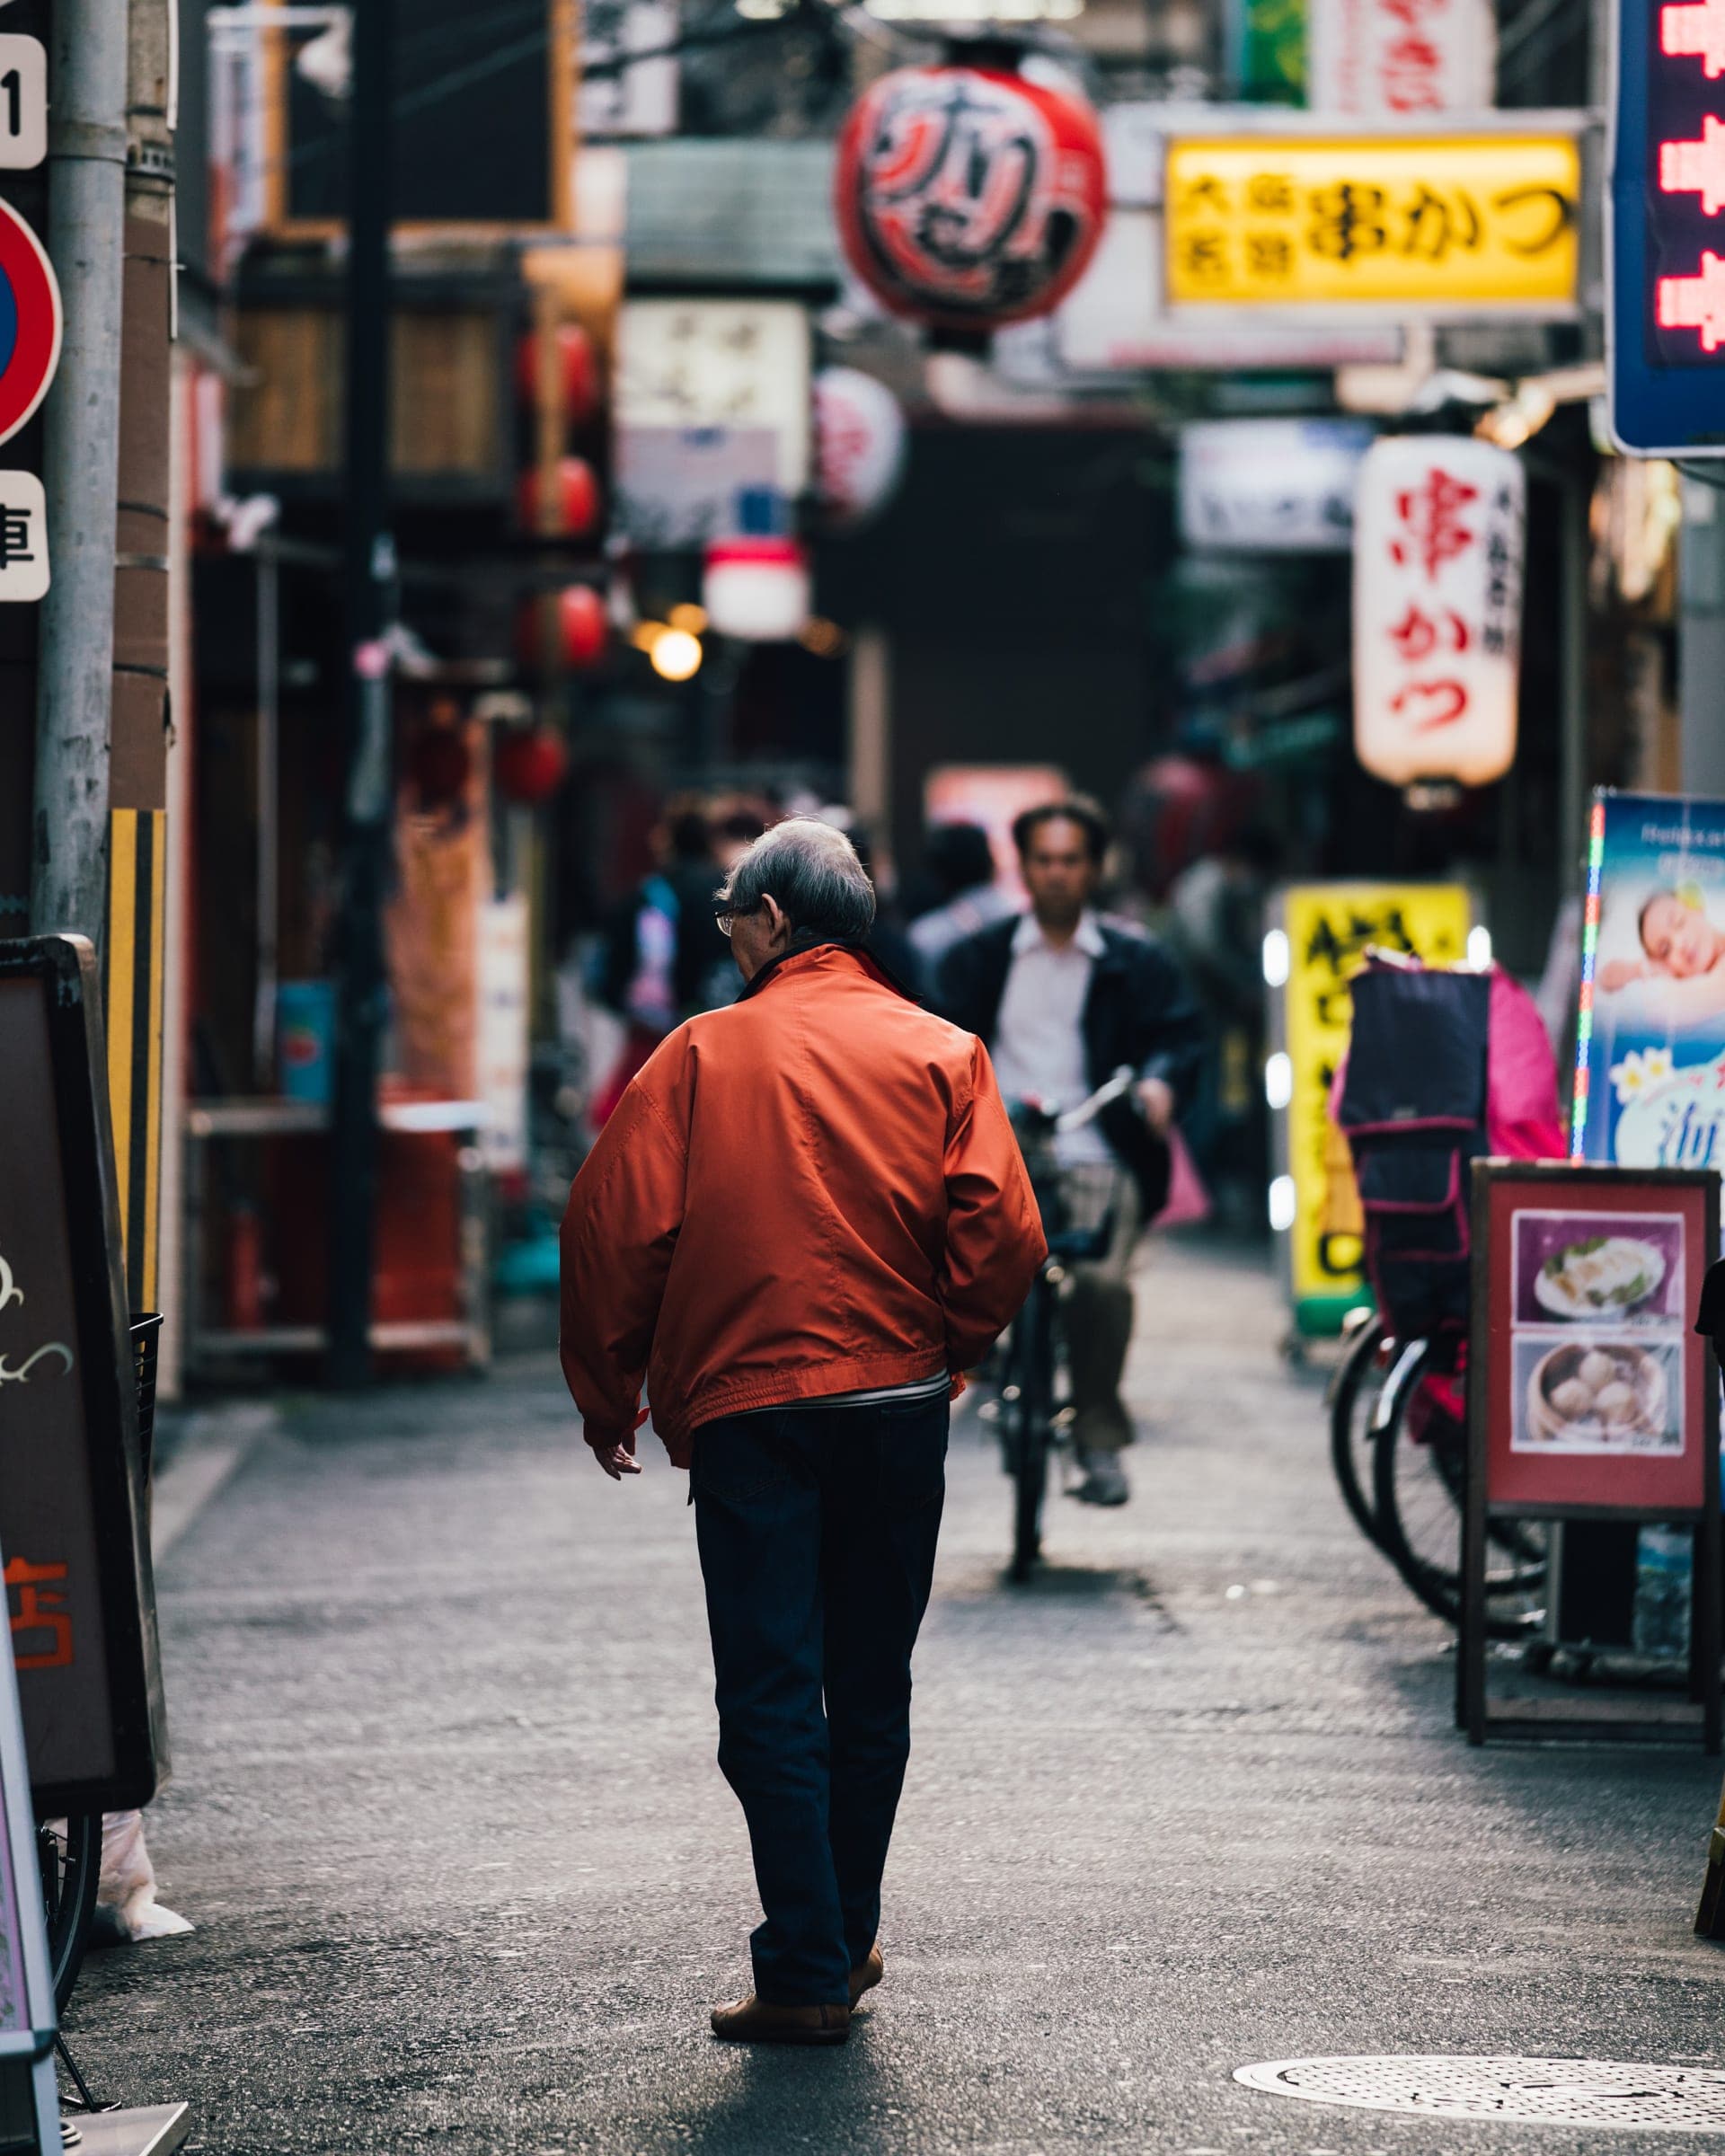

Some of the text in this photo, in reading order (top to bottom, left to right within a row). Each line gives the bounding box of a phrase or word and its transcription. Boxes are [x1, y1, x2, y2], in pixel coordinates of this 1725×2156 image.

[0, 68, 21, 137] 1
[1308, 182, 1572, 262] 串かつ
[1388, 467, 1478, 735] 串かつ
